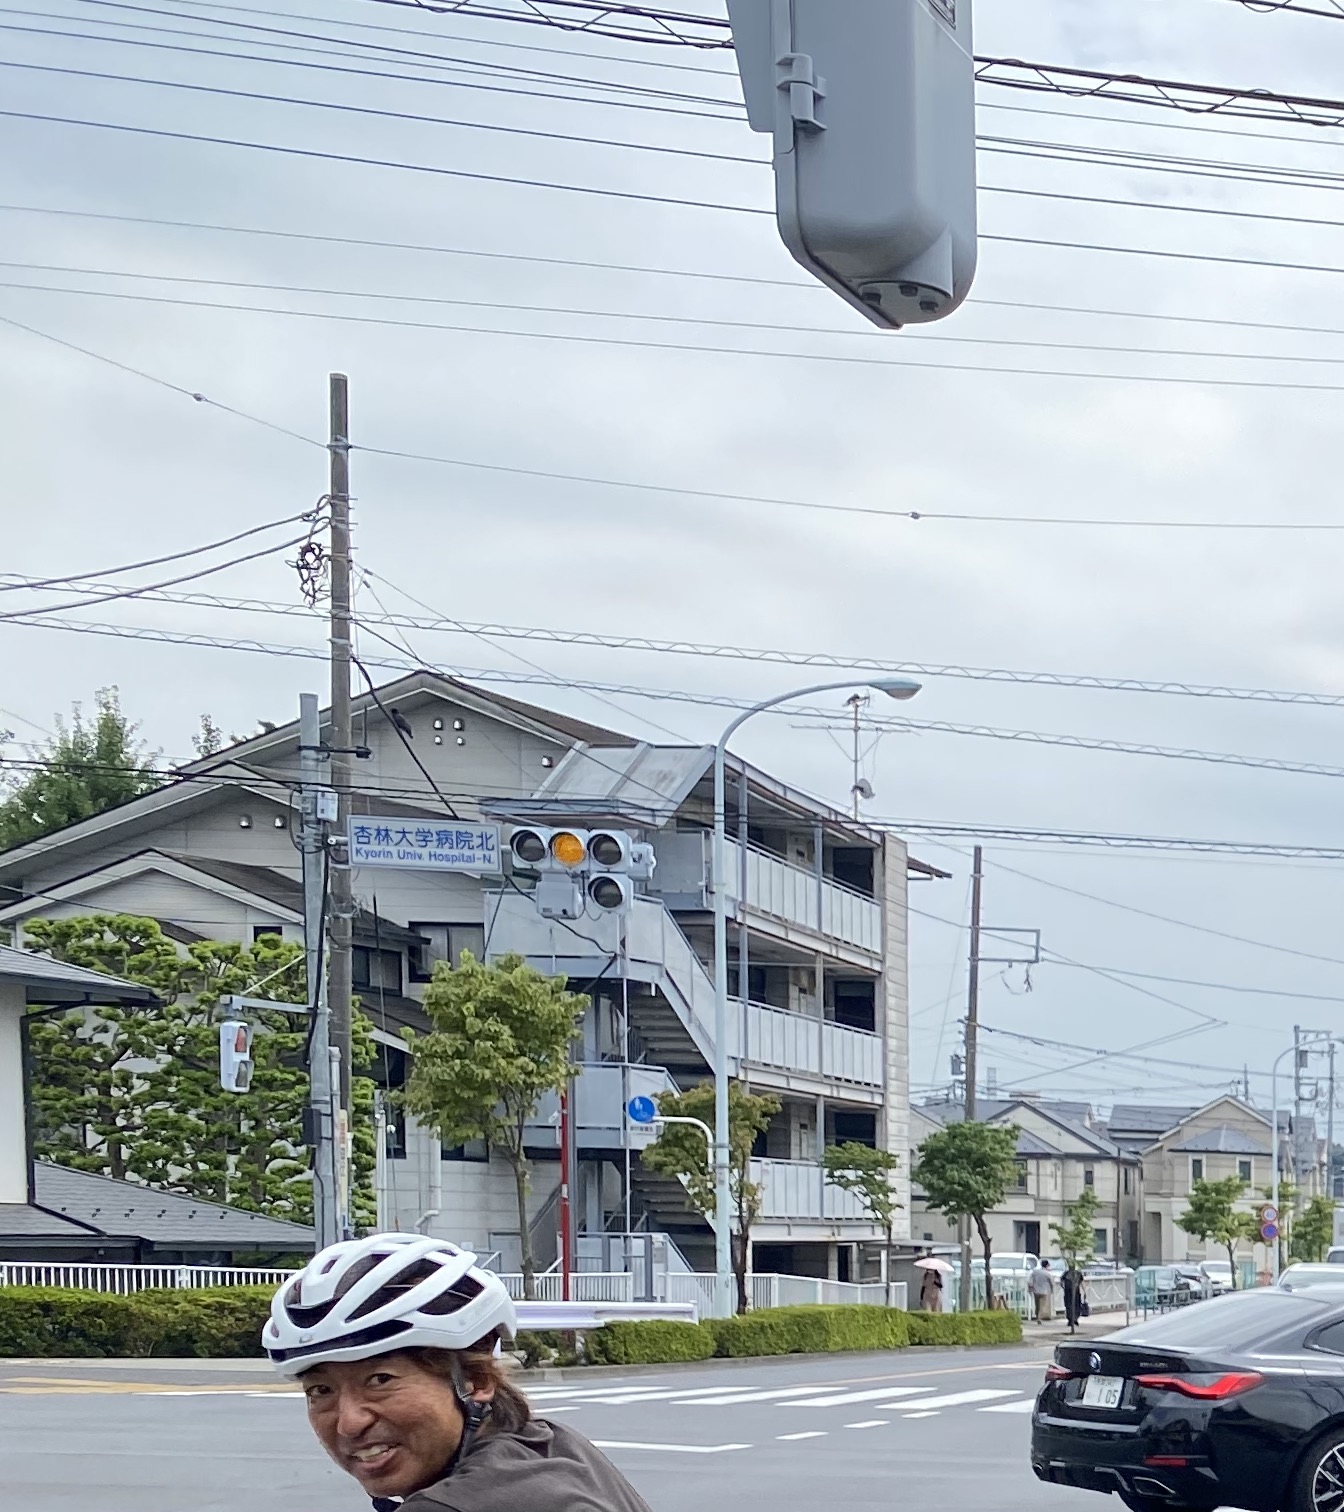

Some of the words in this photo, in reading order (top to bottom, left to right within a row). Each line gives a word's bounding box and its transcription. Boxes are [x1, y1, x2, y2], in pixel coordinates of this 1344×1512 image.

[353, 825, 496, 851] 杏林大学病院北
[355, 847, 394, 860] Kyorin
[397, 850, 425, 860] Univ.
[428, 851, 495, 865] Hospital-N.
